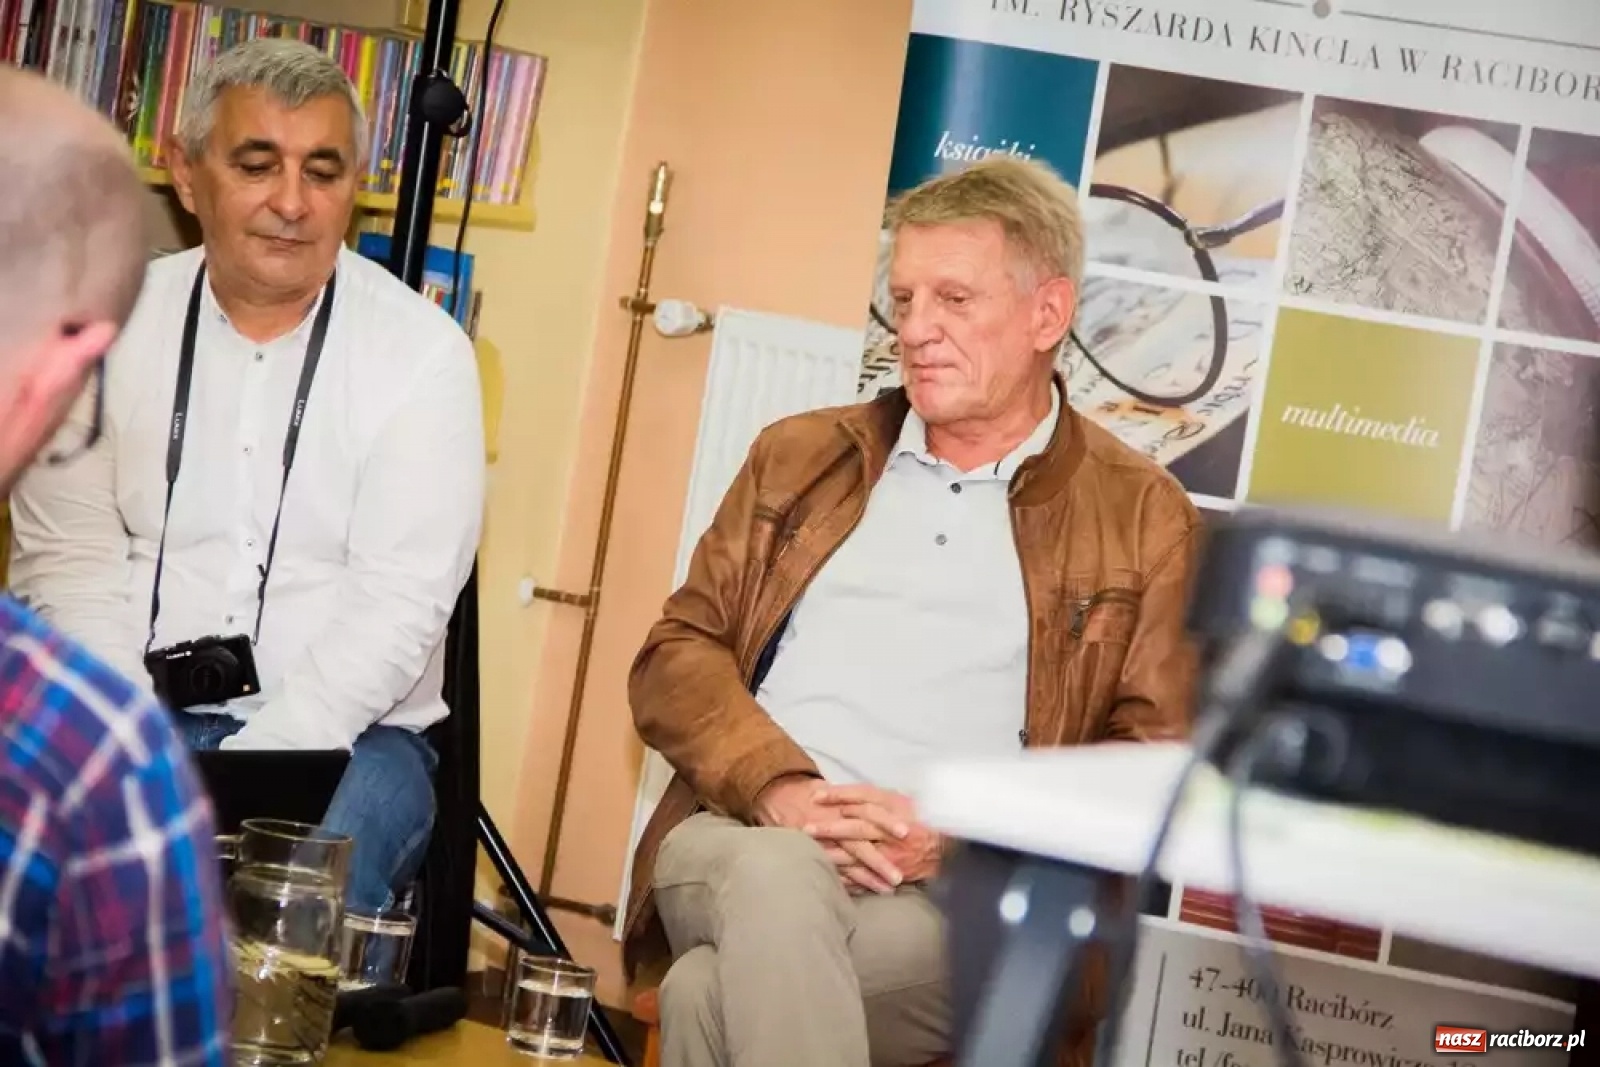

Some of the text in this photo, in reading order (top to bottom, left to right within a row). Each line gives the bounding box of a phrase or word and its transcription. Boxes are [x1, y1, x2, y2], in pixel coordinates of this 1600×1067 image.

[1059, 0, 1232, 47] RYSZARDA
[1249, 25, 1380, 70] KINCLA
[1400, 47, 1428, 73] W
[1280, 402, 1441, 448] multimedia
[1183, 1006, 1210, 1032] ul.
[1215, 1011, 1274, 1046] Jana
[1286, 984, 1395, 1030] Racibórz
